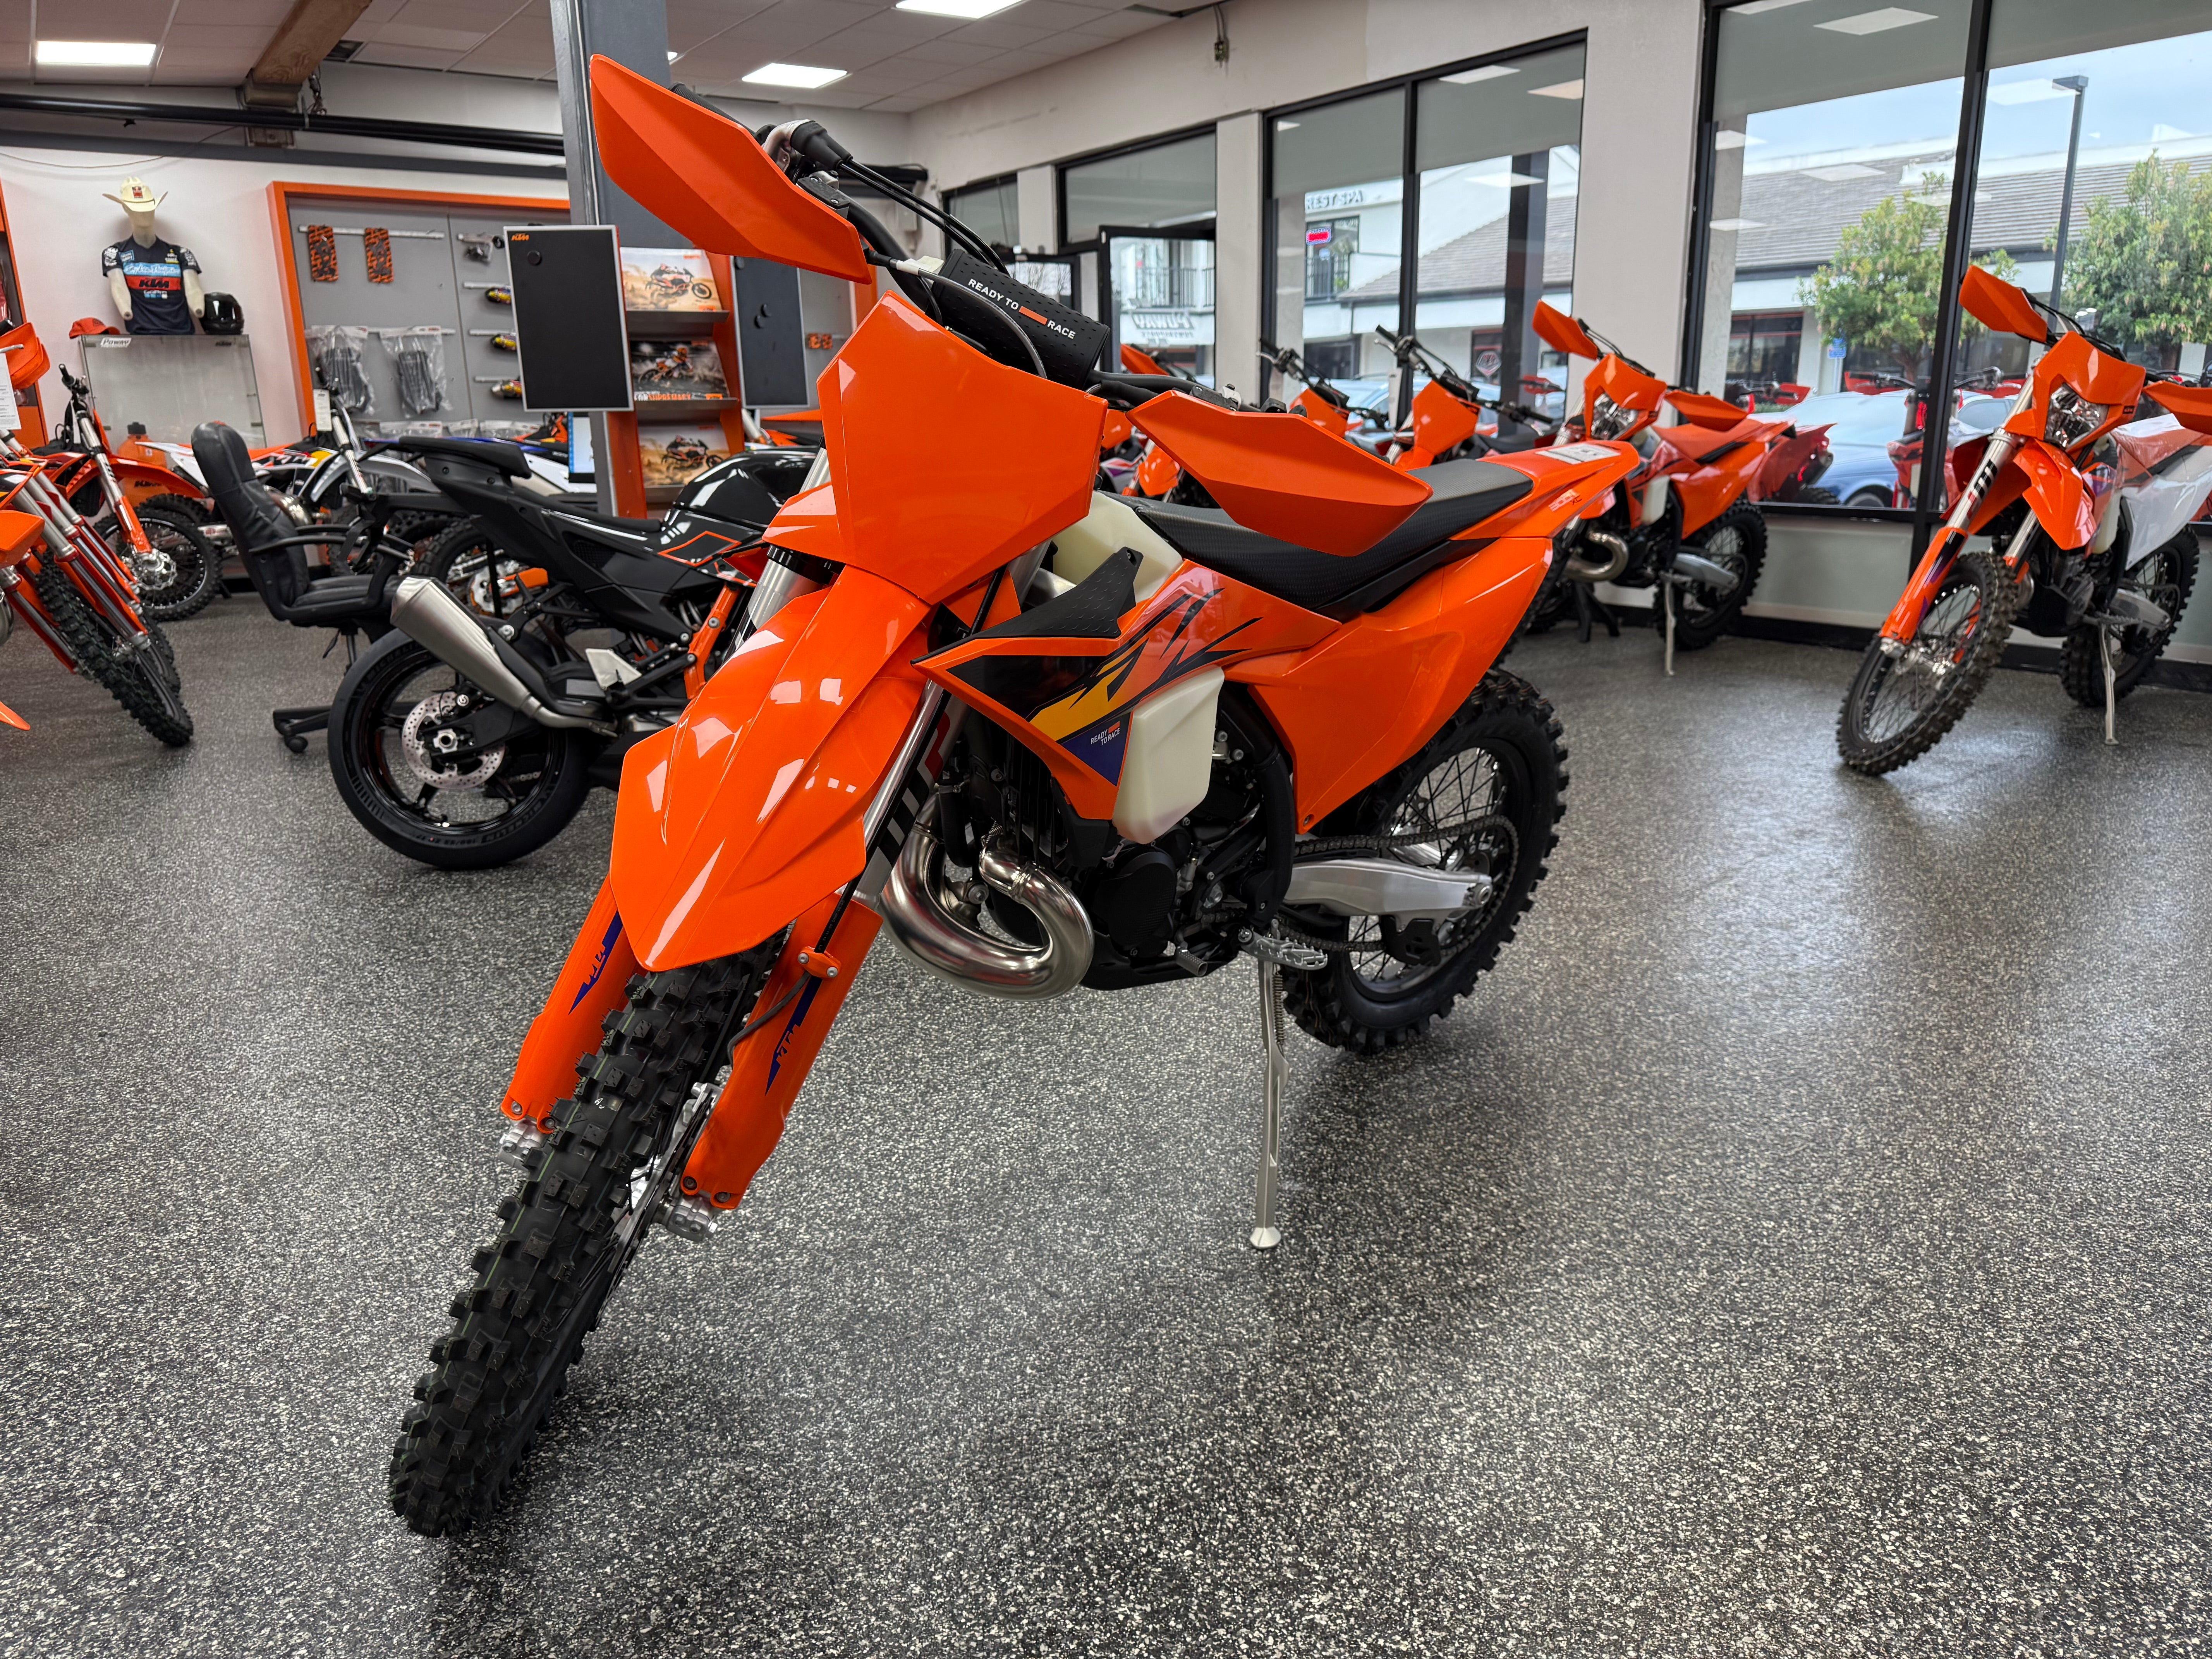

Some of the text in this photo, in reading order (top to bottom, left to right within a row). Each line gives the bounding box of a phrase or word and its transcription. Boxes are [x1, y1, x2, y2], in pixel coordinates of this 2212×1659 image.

[139, 277, 170, 289] KTM
[968, 278, 1076, 339] READY TO RACE
[1091, 728, 1108, 745] READY
[1101, 728, 1120, 745] TO RACE
